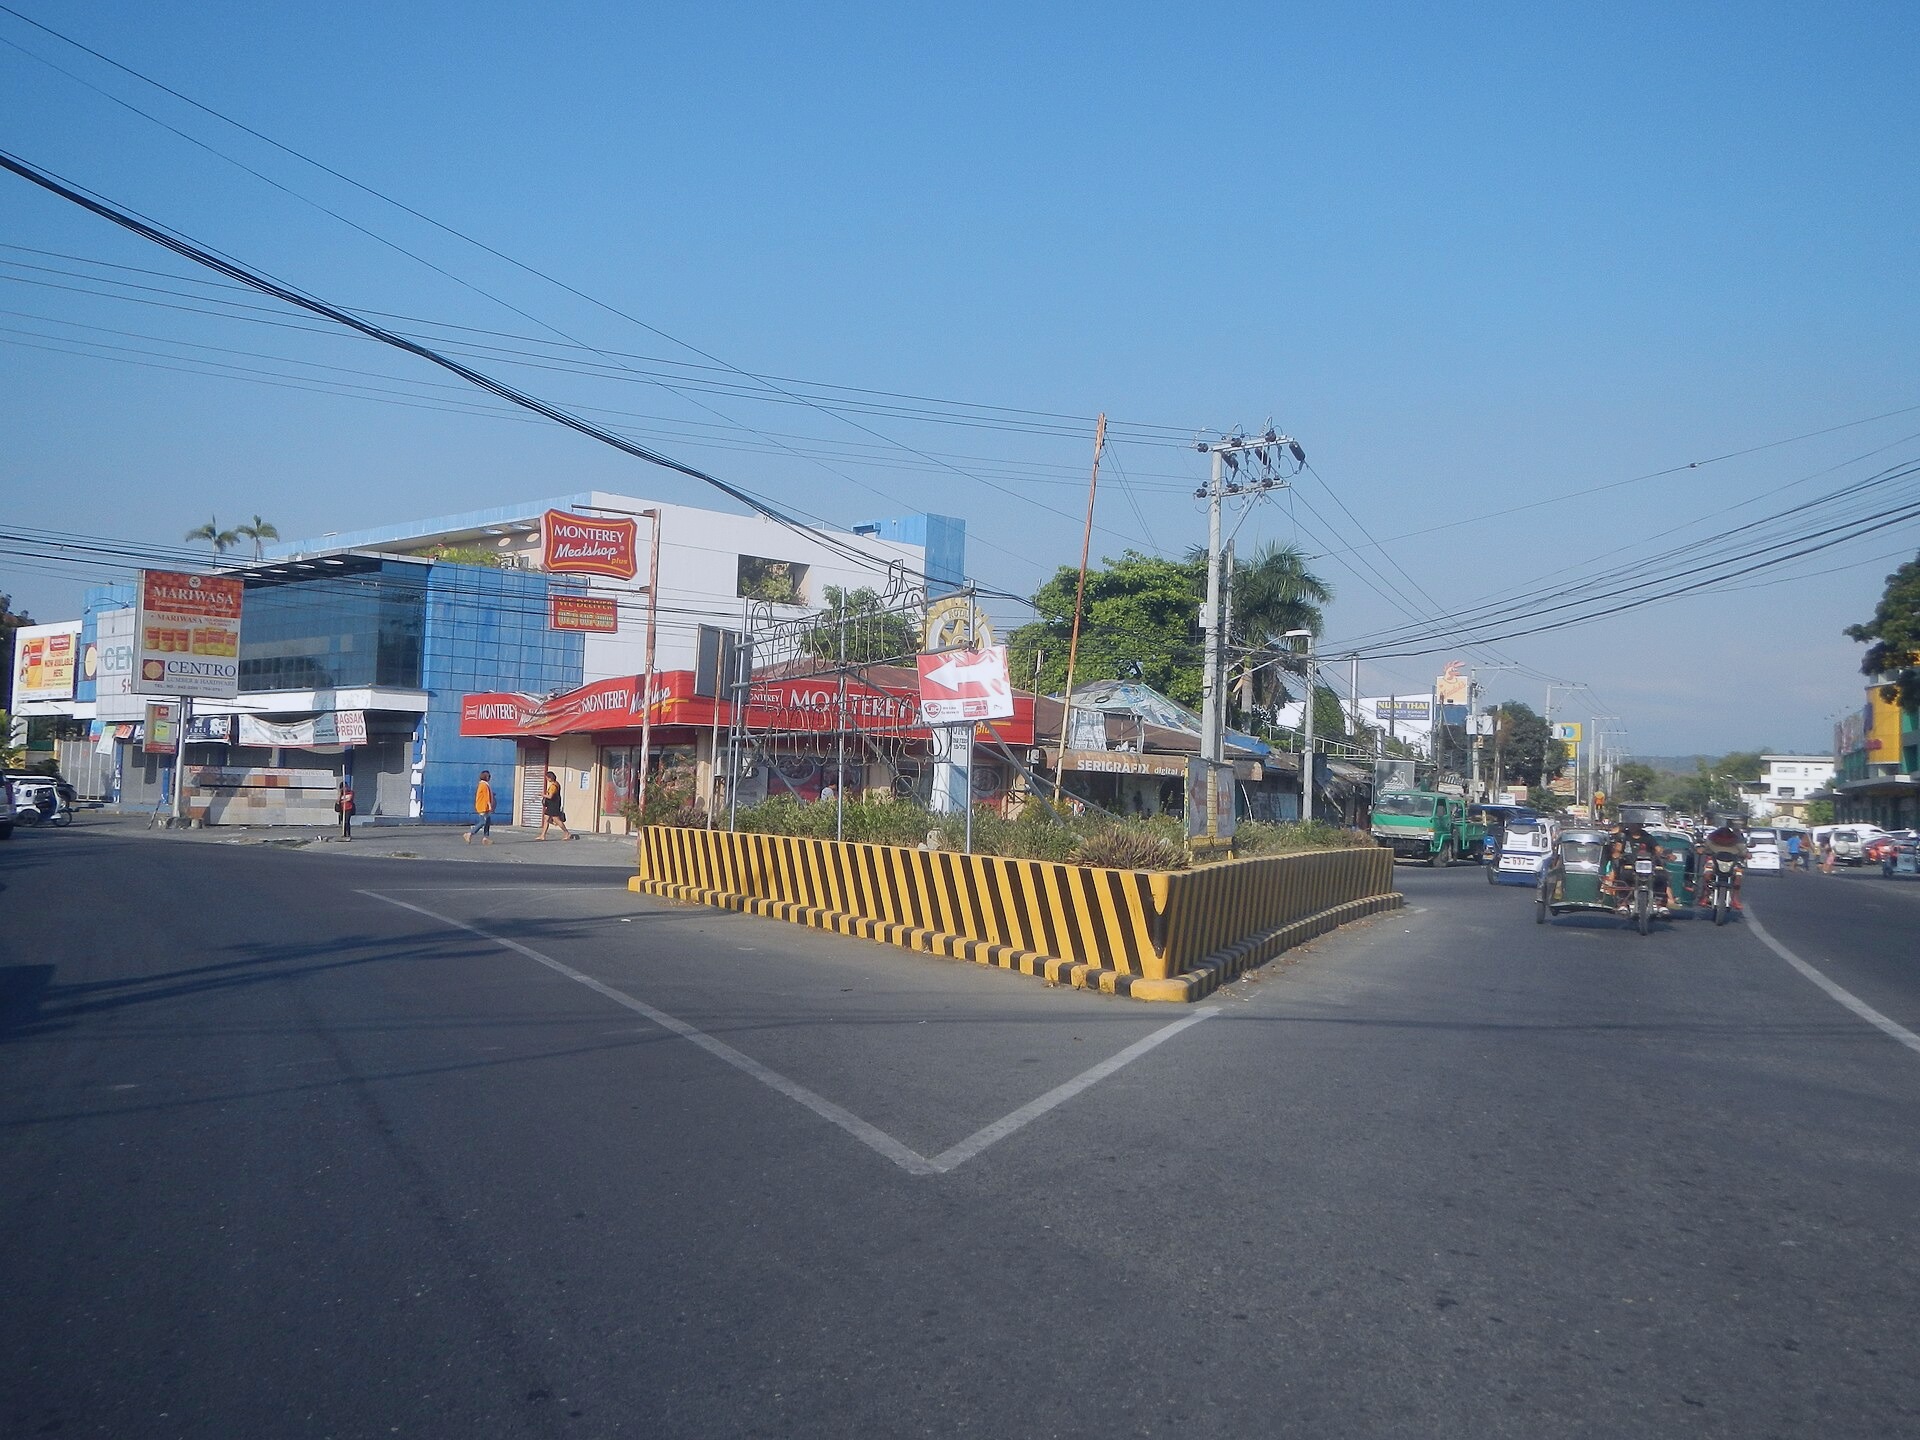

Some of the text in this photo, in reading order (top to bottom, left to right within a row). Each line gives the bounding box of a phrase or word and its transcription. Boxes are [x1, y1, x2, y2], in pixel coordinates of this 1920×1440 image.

[554, 525, 625, 543] MONTEREY
[554, 541, 618, 560] Meatshop
[611, 557, 628, 565] plus
[154, 586, 234, 605] MARIWASA
[157, 613, 203, 624] MARIWASA
[167, 660, 237, 678] CENTRO
[581, 689, 630, 713] MONTEREY
[629, 682, 671, 715] Meashop
[789, 688, 911, 719] MONTEREY
[1406, 702, 1429, 710] THAI
[334, 712, 364, 725] BAGSAK
[336, 725, 364, 736] PRESYO
[975, 722, 991, 735] plu
[1077, 759, 1150, 774] SERIGRAFIX
[1154, 765, 1178, 776] digital
